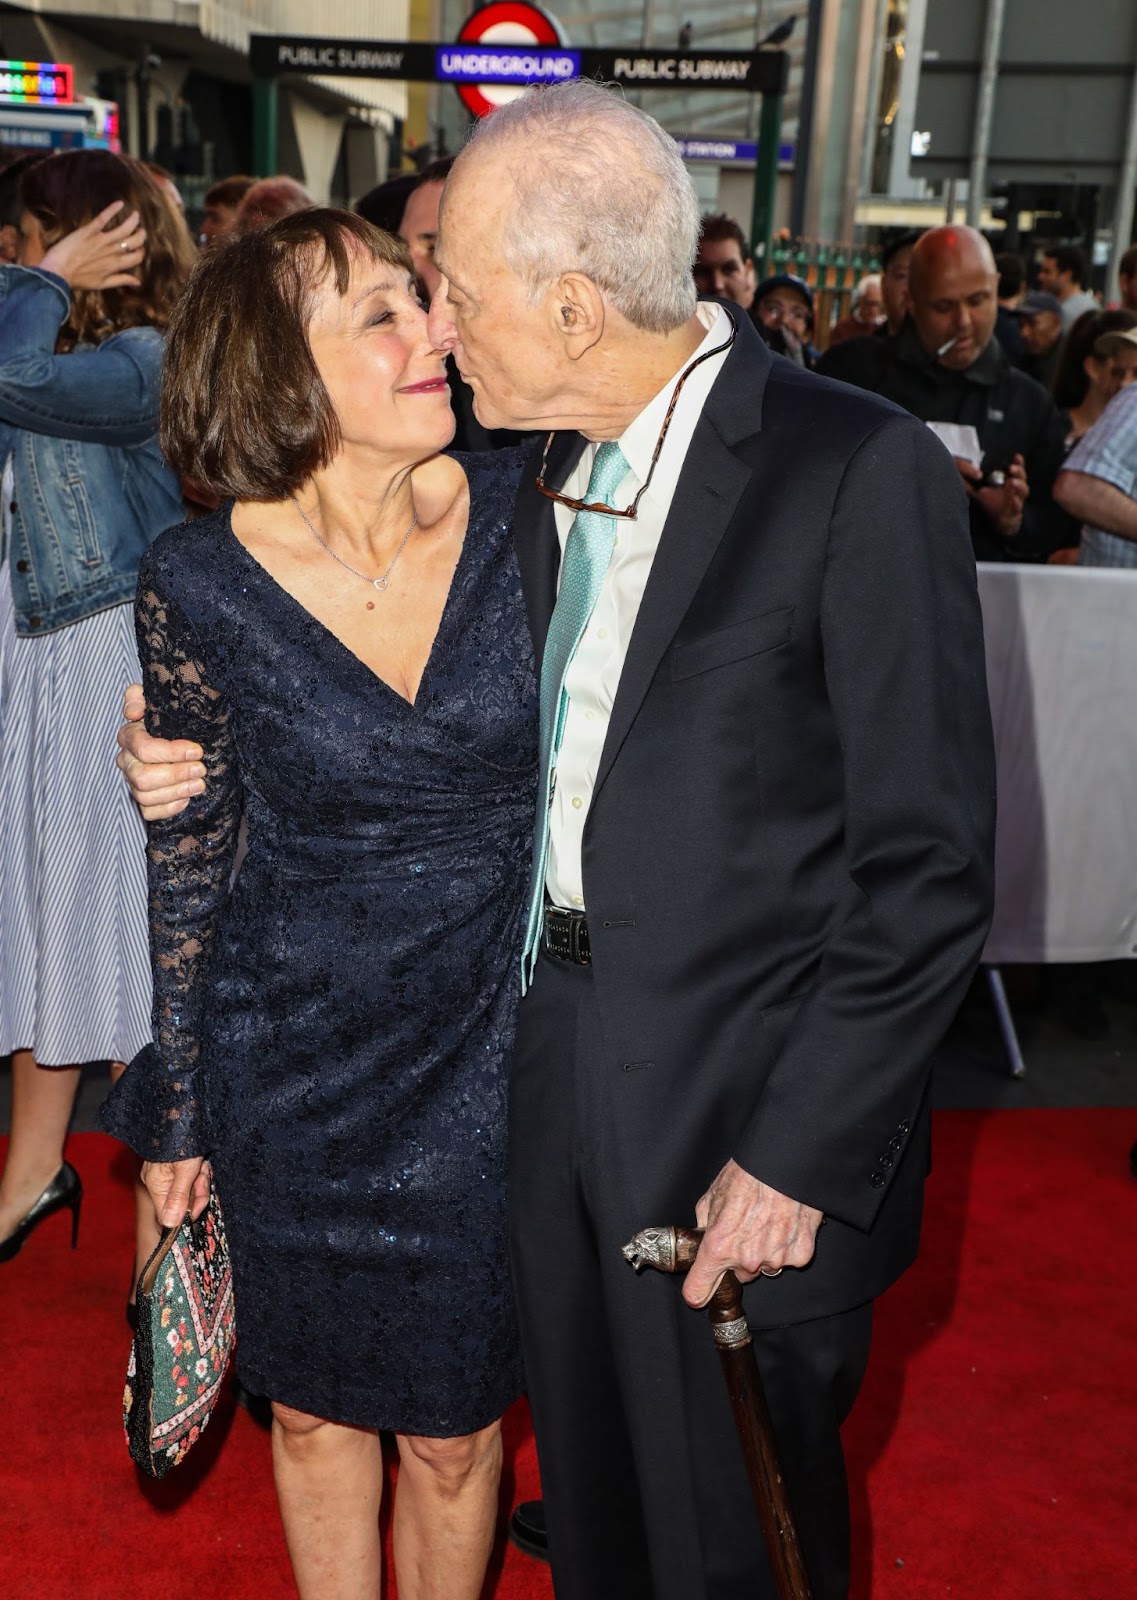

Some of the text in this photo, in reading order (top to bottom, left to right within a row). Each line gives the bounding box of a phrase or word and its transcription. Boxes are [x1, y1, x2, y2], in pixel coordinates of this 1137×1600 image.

[278, 46, 404, 70] PUBLIC SUBWAY
[441, 53, 575, 77] UNDERGROUND
[614, 57, 751, 80] PUBLIC SUBWAY
[686, 141, 737, 158] STATION
